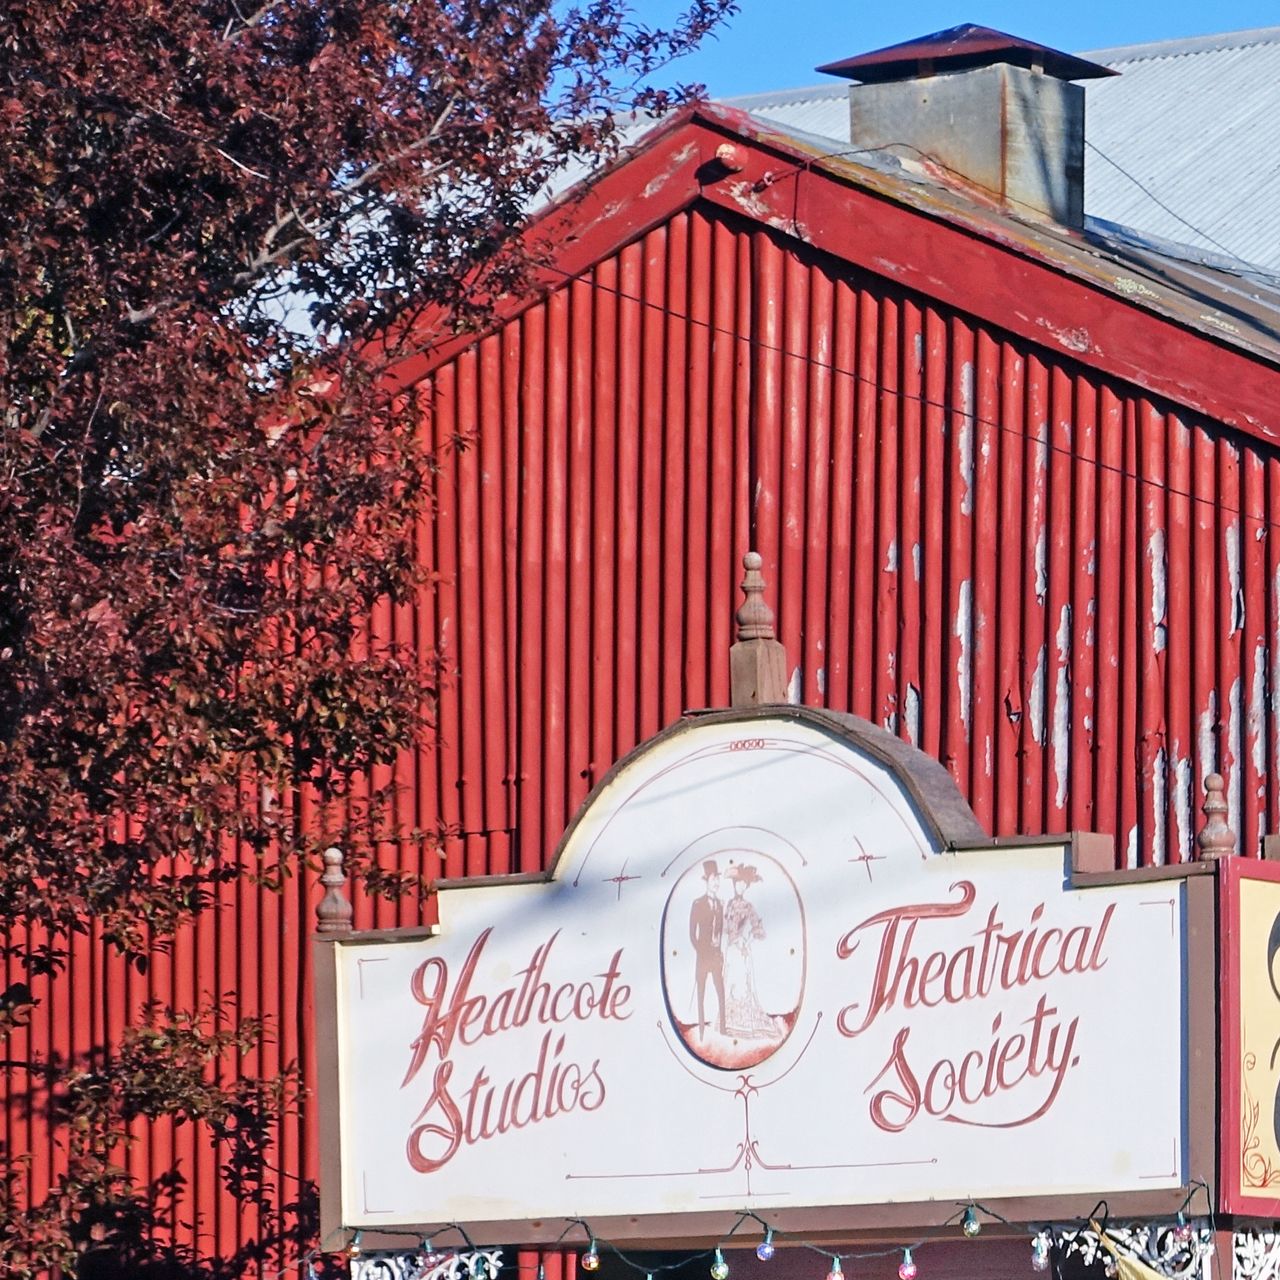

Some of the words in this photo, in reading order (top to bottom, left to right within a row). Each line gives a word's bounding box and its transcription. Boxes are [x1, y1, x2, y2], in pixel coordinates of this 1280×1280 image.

[401, 927, 634, 1088] Heathcote
[837, 880, 1117, 1038] Theatrical
[406, 1028, 606, 1172] Studios
